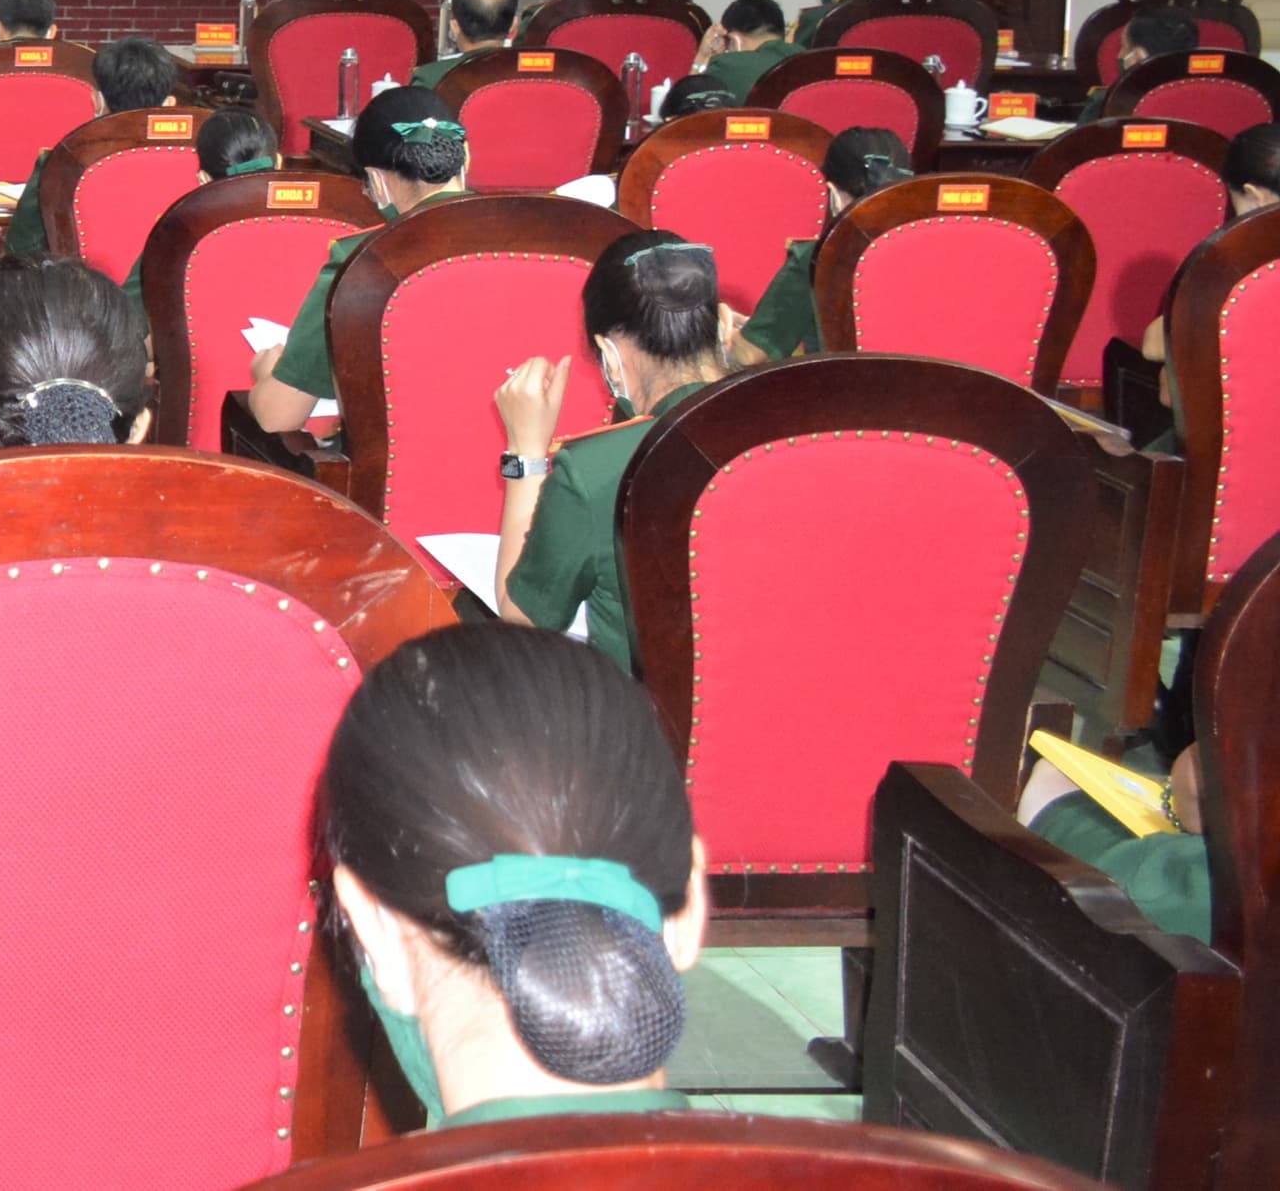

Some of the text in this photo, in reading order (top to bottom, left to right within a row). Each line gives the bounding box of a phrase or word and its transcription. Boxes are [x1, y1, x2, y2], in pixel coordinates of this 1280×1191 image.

[20, 52, 40, 61] KHOA
[154, 122, 178, 132] KHOA
[276, 189, 303, 201] KHOA
